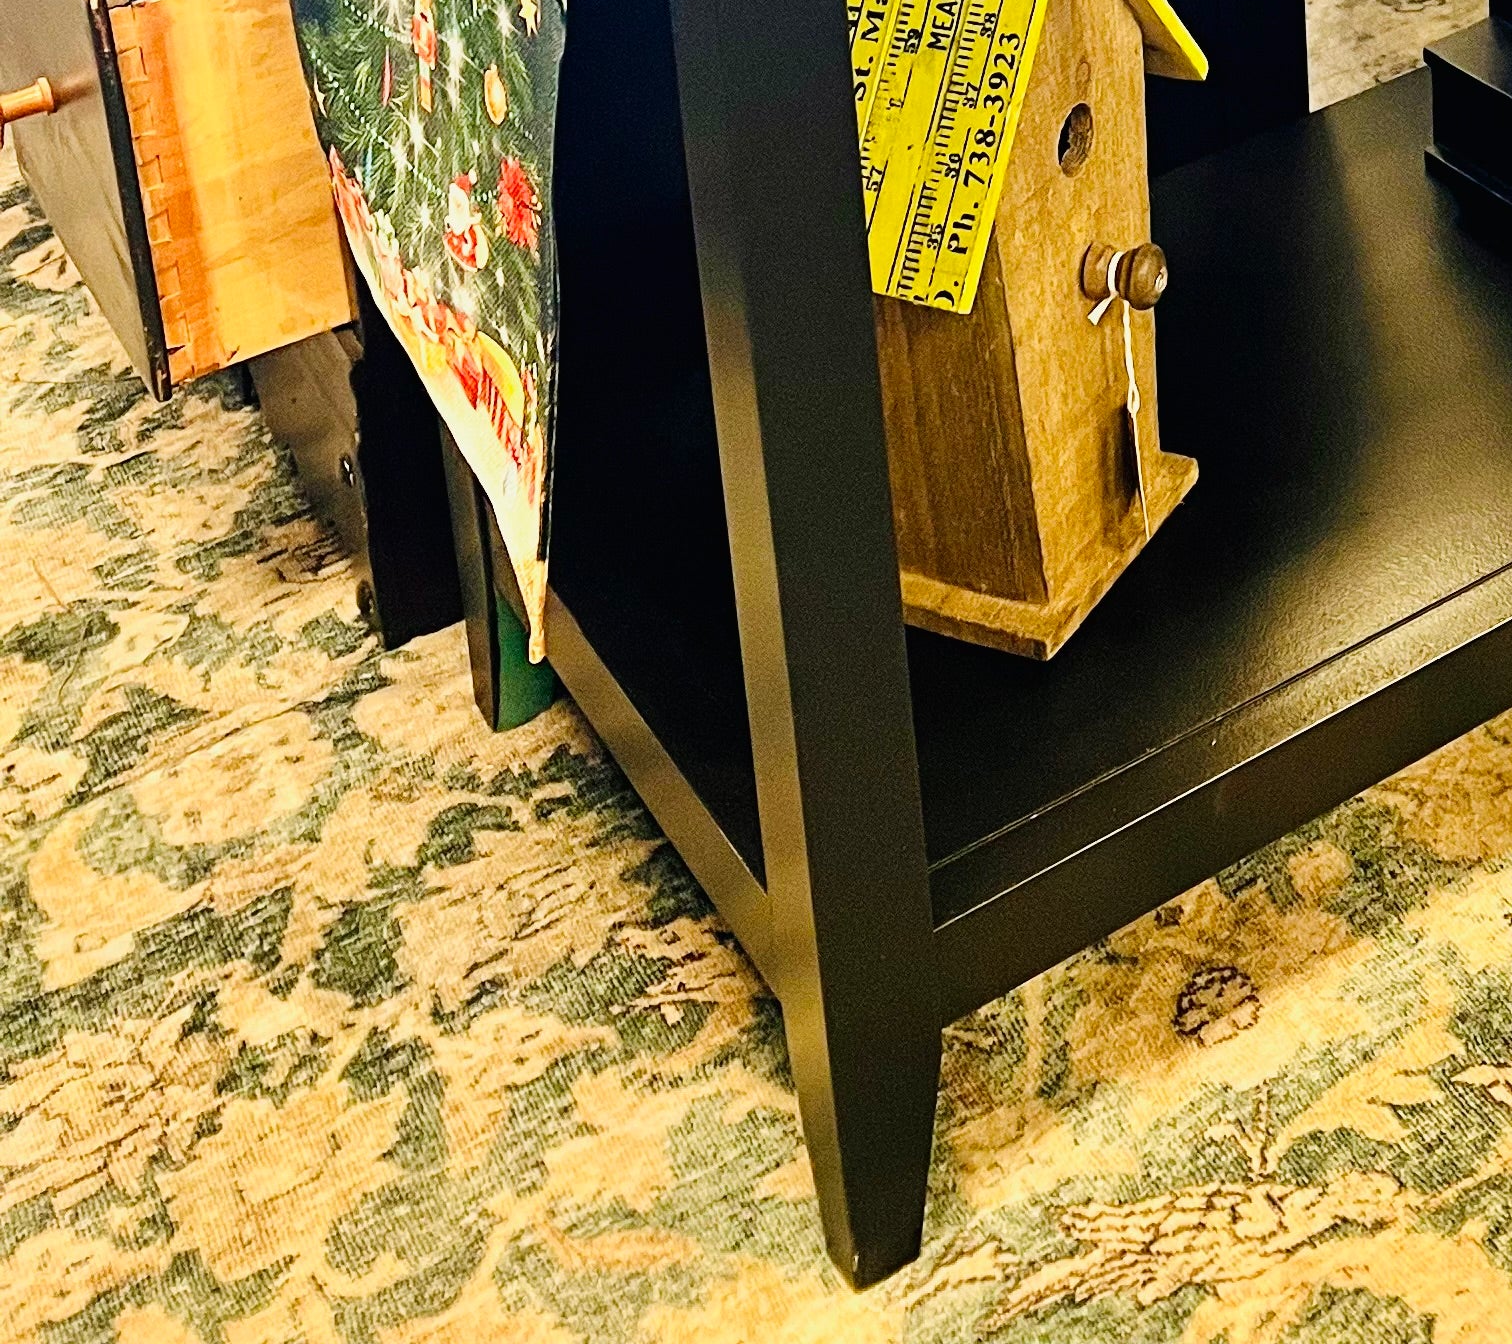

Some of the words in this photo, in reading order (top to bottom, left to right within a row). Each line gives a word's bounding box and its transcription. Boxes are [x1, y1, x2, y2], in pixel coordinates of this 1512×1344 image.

[855, 55, 875, 102] St.
[926, 223, 944, 250] 35
[962, 81, 980, 109] 37
[979, 12, 998, 38] 38
[947, 201, 979, 255] Ph.
[963, 32, 1022, 188] 738-3923
[865, 165, 883, 192] 57
